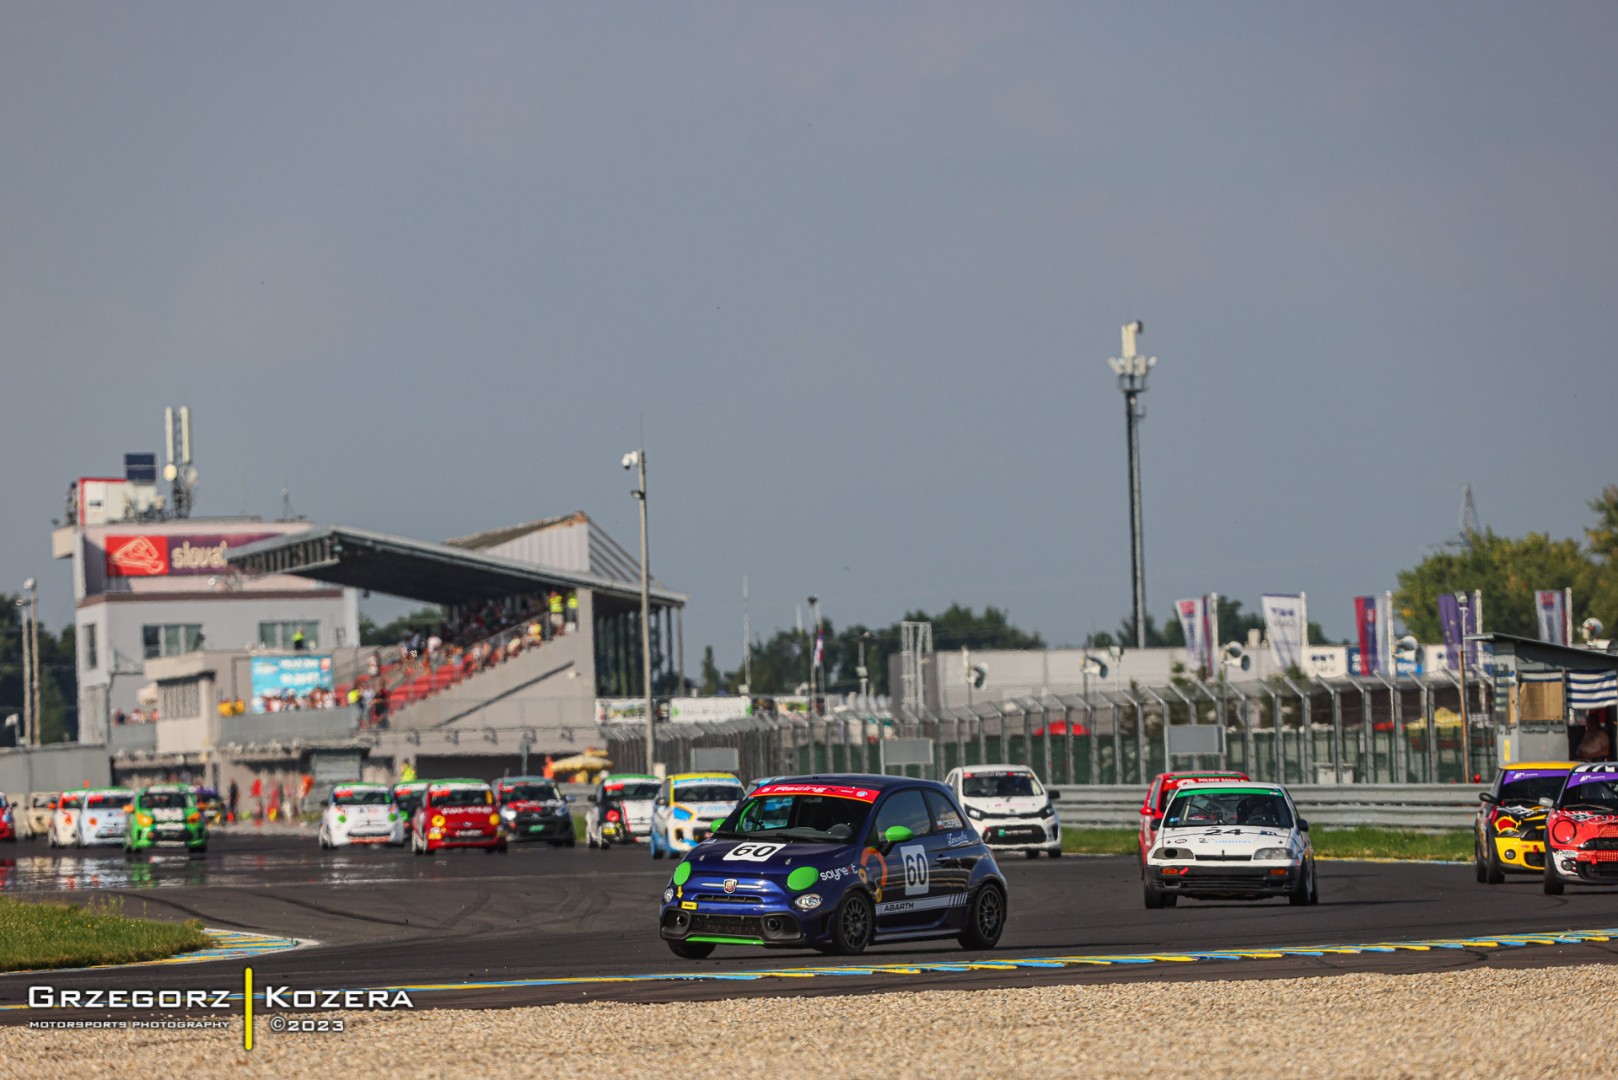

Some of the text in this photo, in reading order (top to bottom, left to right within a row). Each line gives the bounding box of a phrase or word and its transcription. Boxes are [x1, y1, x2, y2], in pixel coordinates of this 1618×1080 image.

[1204, 828, 1243, 836] 24
[732, 844, 777, 858] 60
[905, 852, 928, 887] 60
[883, 902, 915, 912] ABARTH
